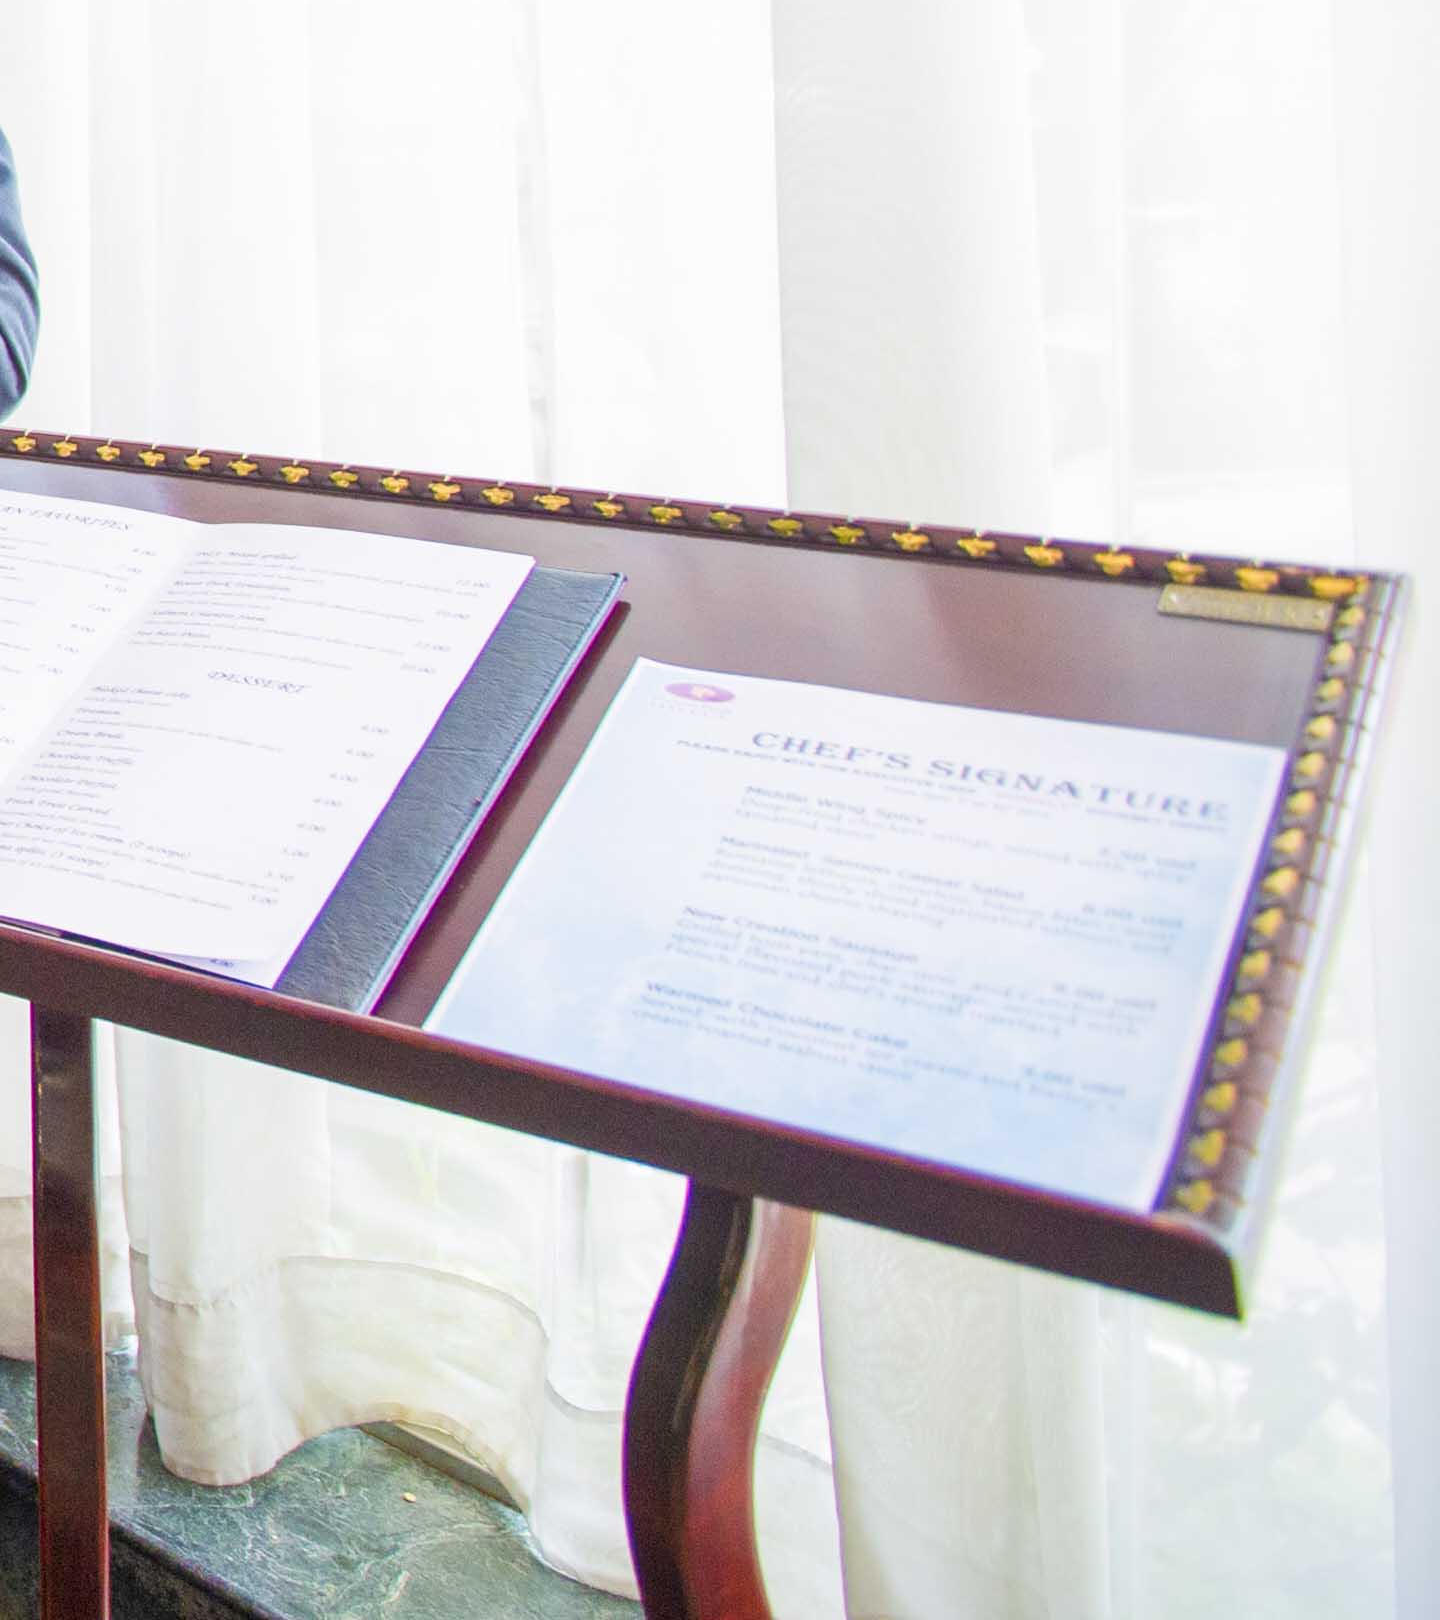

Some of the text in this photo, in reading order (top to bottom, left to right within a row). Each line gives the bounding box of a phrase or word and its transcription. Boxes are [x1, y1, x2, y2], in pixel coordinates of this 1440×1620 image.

[28, 508, 135, 532] FAVORITES
[207, 669, 311, 693] DESSERT
[751, 730, 913, 771] CHEF'S
[927, 758, 1231, 822] SIGNATURE
